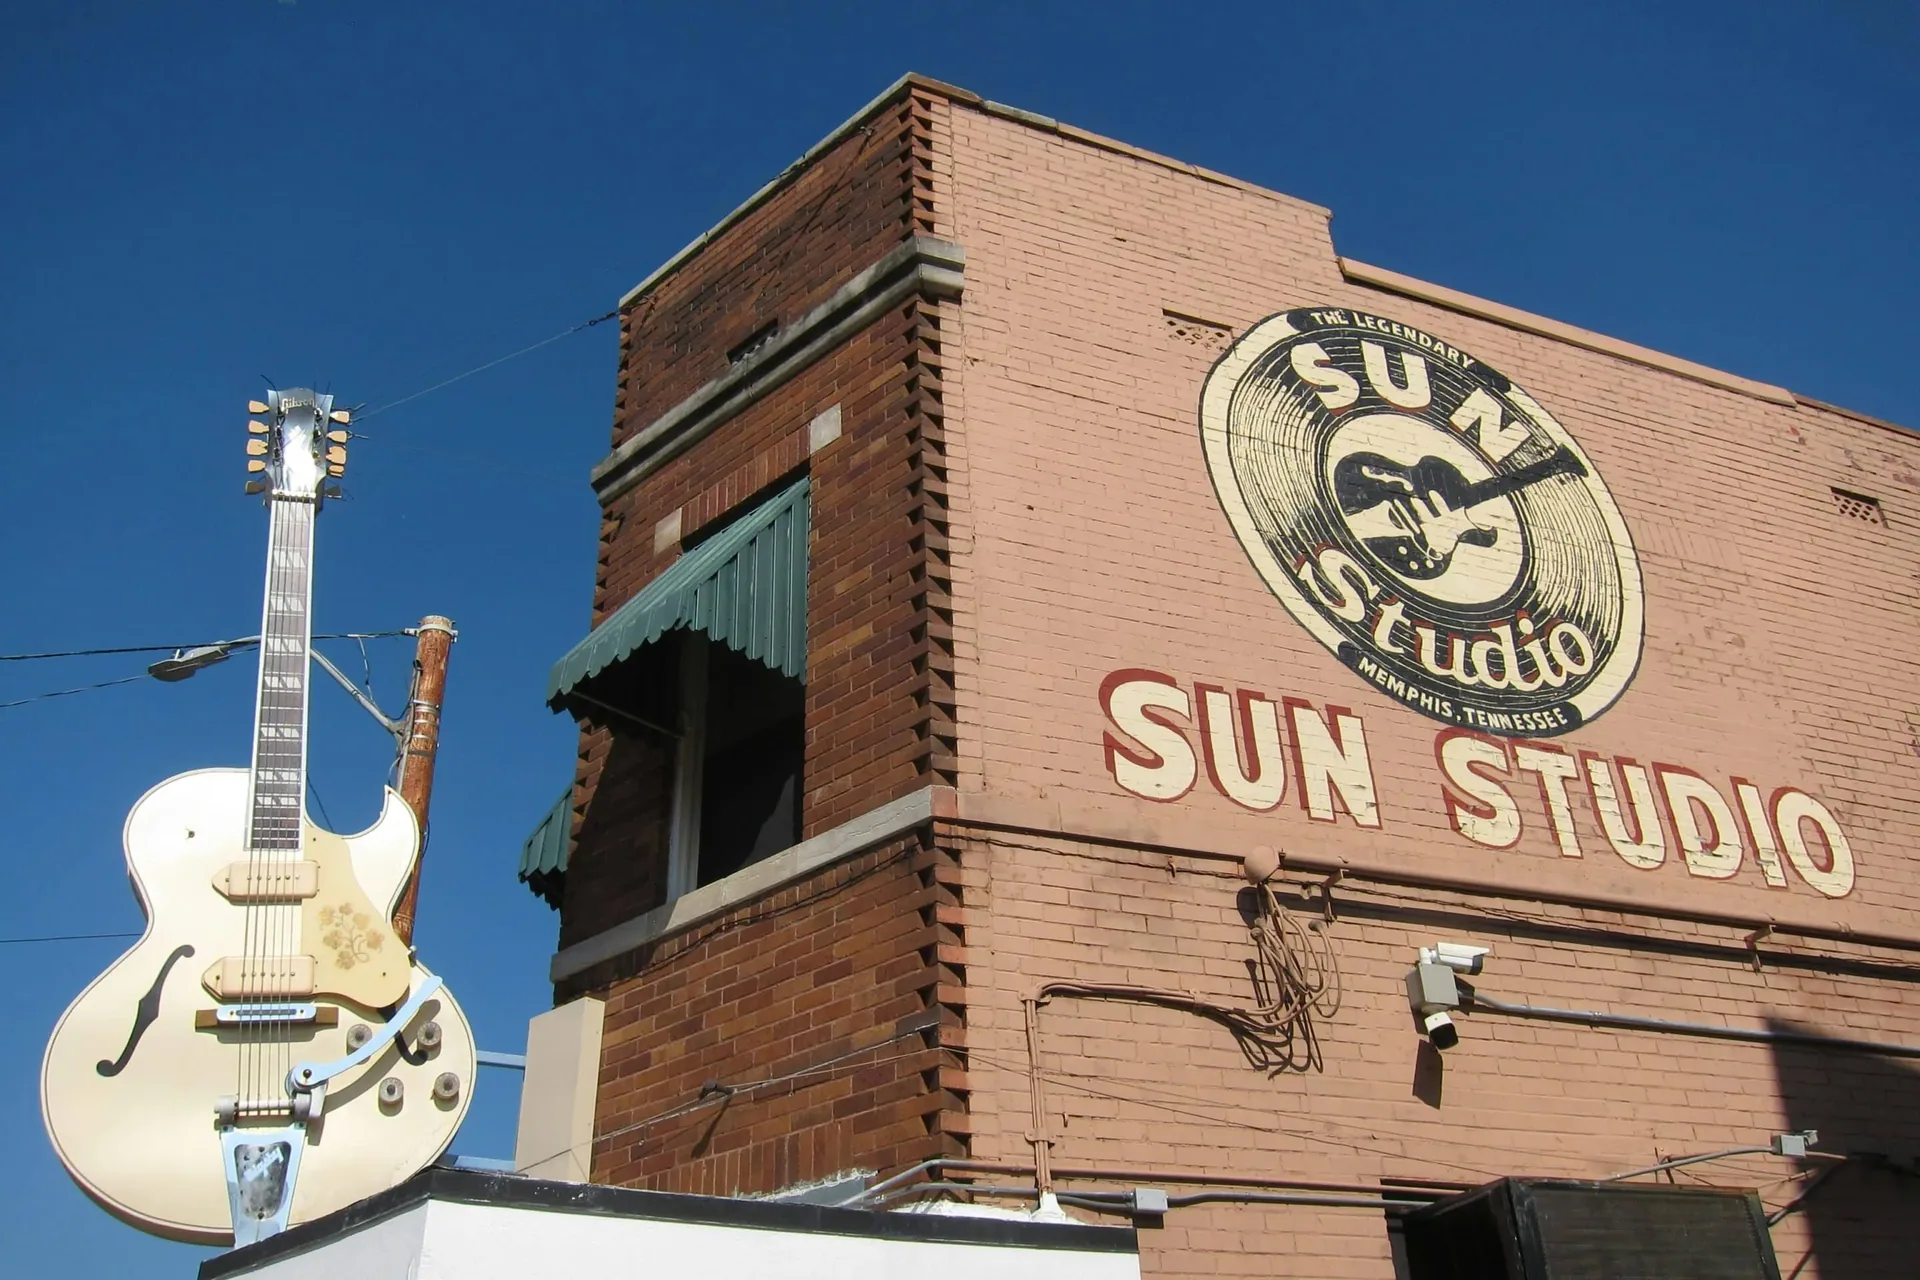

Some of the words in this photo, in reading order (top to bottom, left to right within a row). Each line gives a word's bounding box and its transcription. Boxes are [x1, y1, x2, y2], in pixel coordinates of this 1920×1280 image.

[1310, 309, 1350, 325] THE
[1352, 311, 1476, 369] LEGENDARY
[281, 397, 315, 414] Gibson
[1290, 339, 1535, 464] SUN
[1296, 544, 1594, 691] Studio
[1358, 656, 1462, 722] MEMPHIS,
[1462, 706, 1568, 731] TENNESSEE
[1101, 668, 1382, 831] SUN
[1435, 729, 1856, 898] STUDIO
